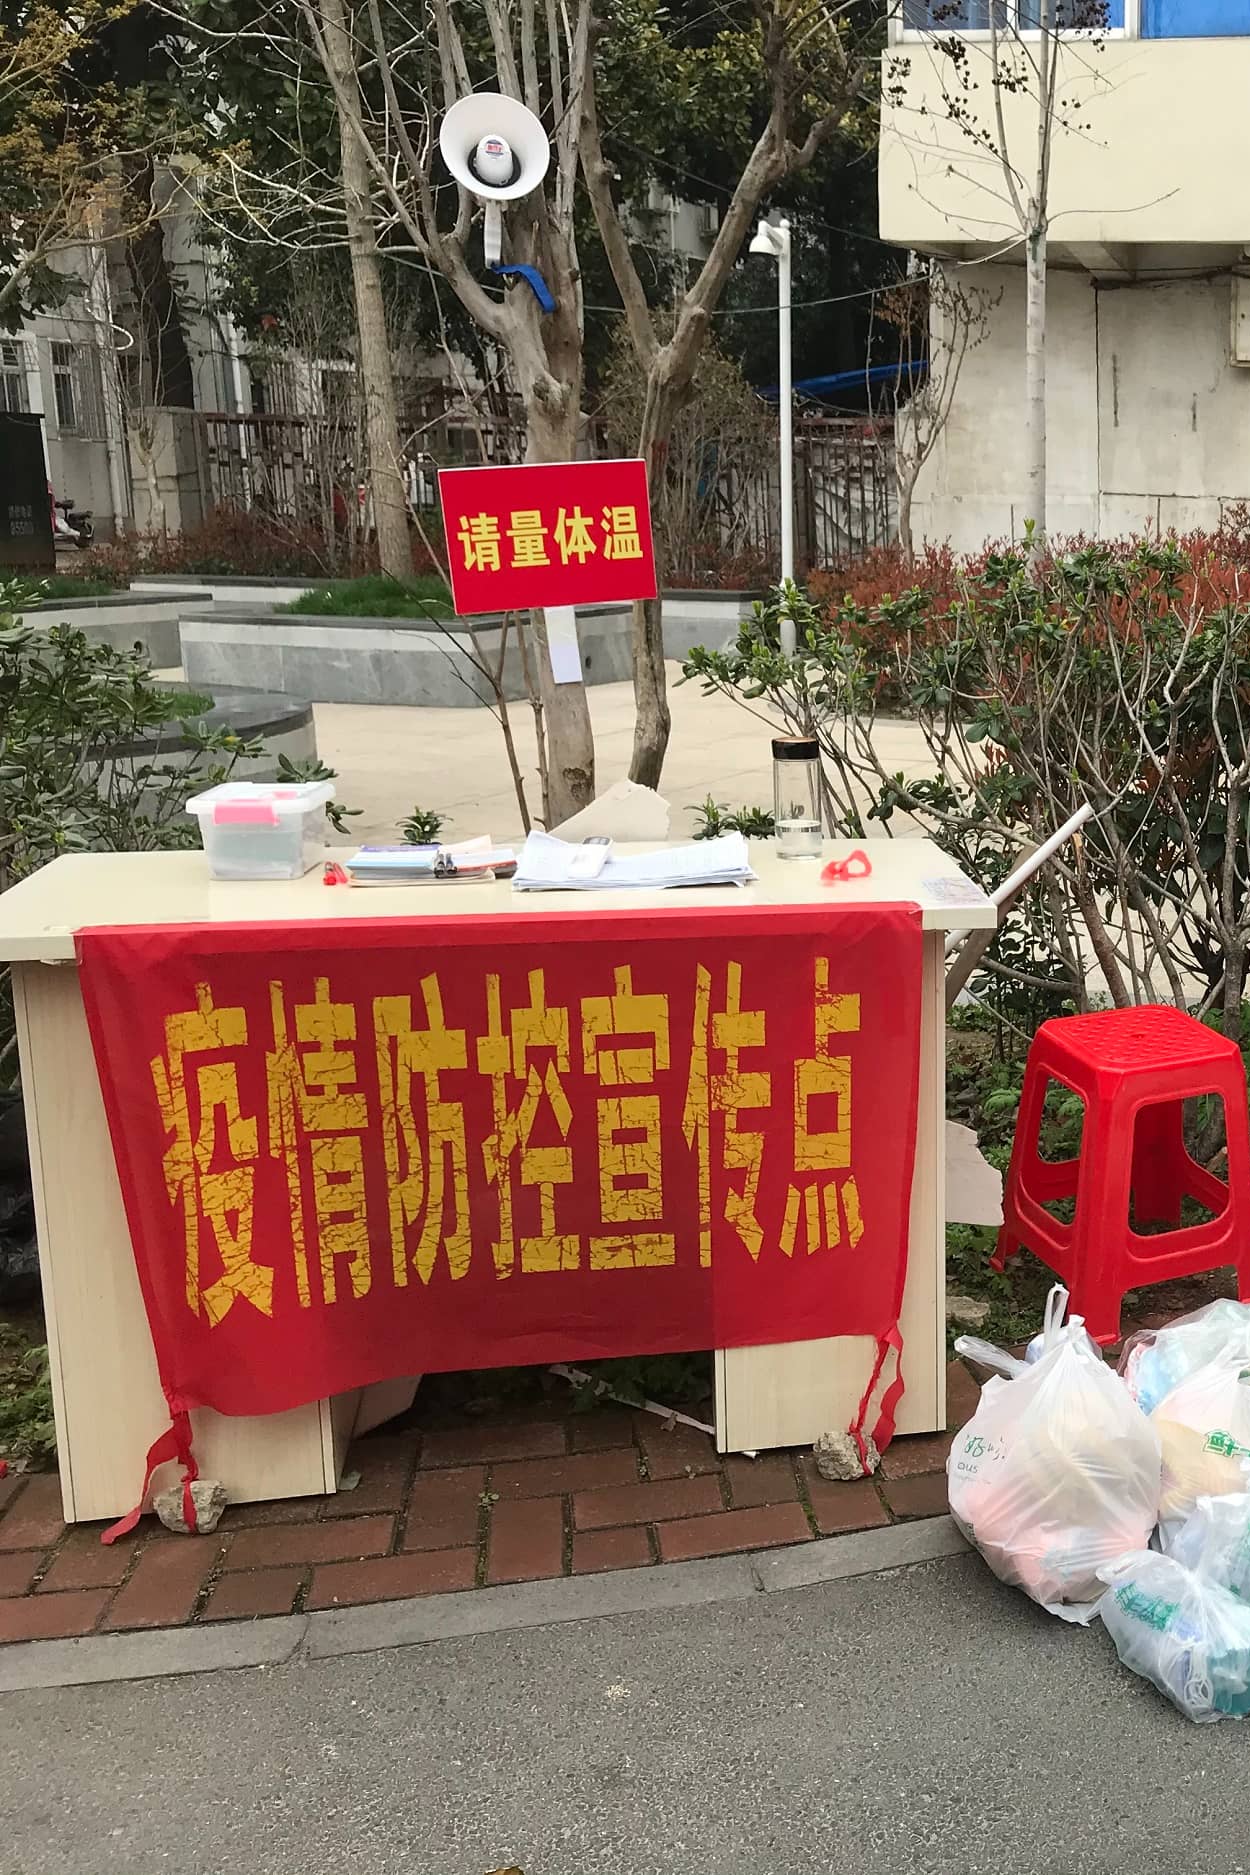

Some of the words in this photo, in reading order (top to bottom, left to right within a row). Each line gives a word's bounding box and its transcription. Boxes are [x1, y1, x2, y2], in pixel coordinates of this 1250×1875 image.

[456, 505, 644, 572] 请量体温
[149, 956, 864, 1328] 疫情防控宣传点
